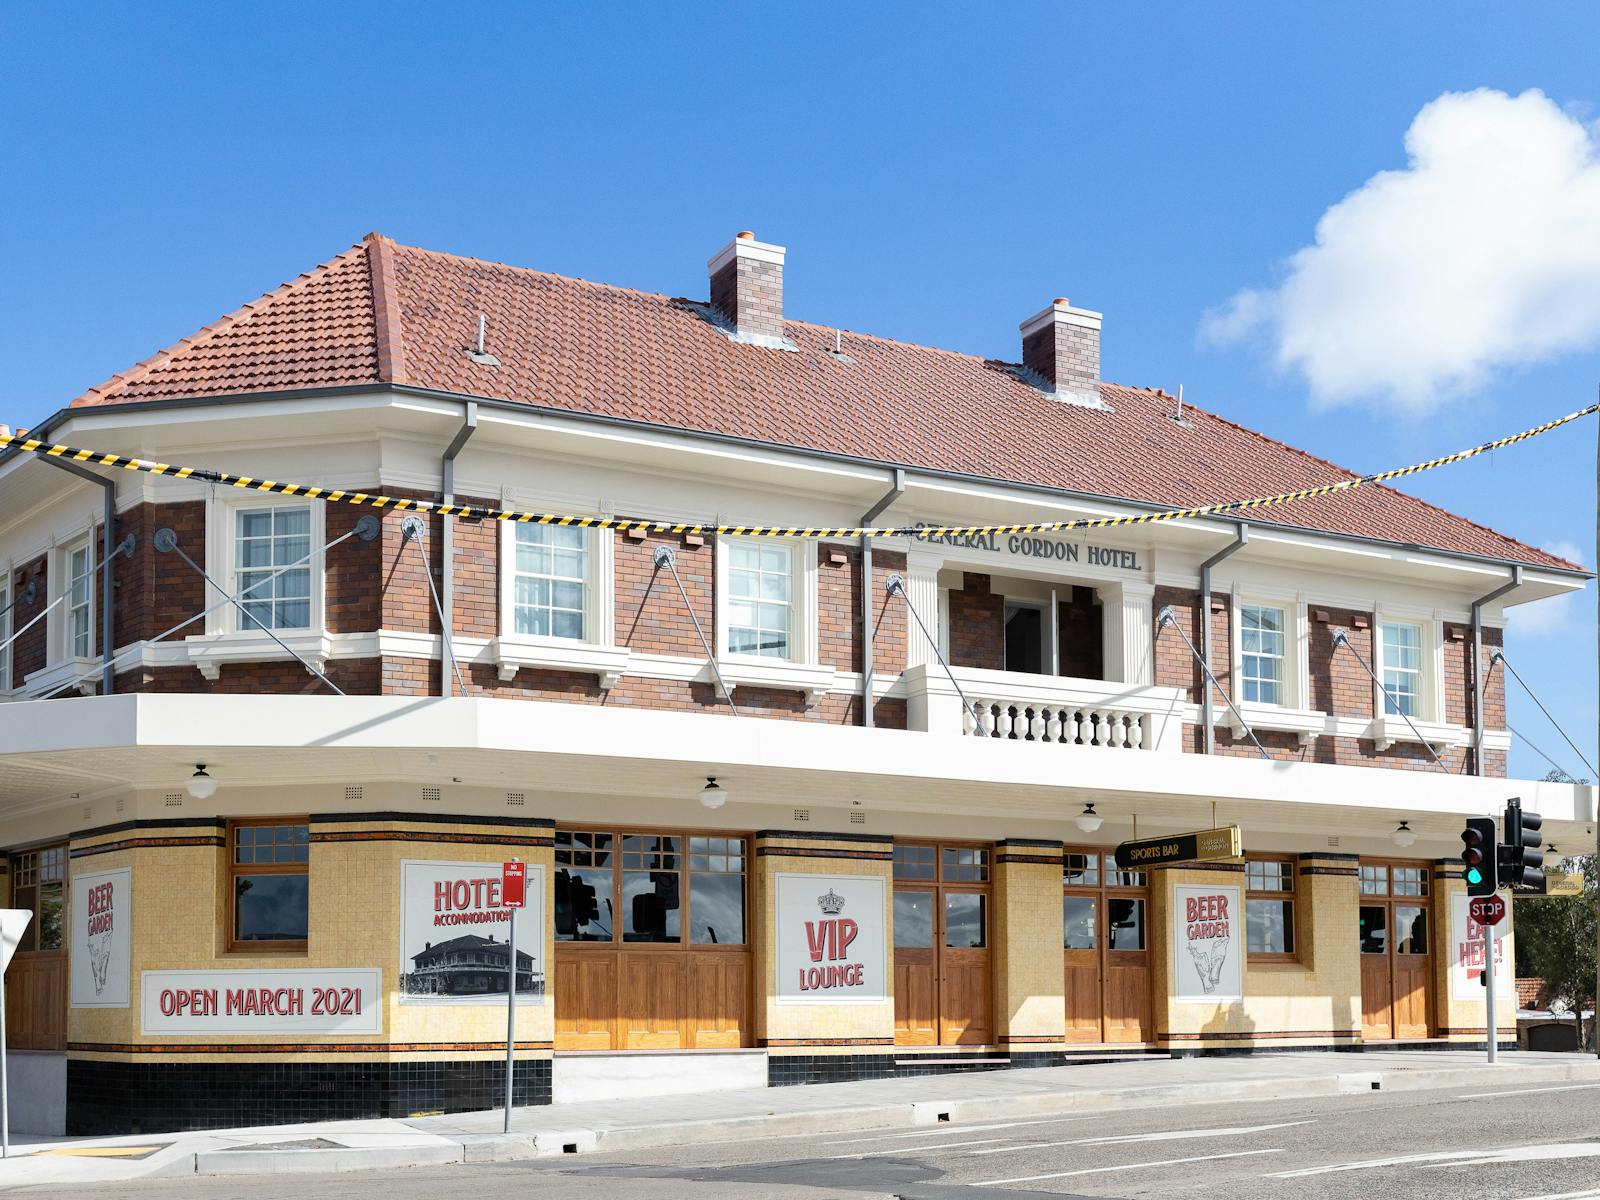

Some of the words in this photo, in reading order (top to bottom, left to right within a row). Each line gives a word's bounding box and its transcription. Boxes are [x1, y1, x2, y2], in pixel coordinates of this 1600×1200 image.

[914, 522, 1001, 552] GENERAL
[1007, 535, 1079, 562] GORDON
[1087, 545, 1142, 571] HOTEL
[1130, 845, 1161, 860] SPORTS
[1162, 843, 1180, 857] BAR
[88, 882, 114, 917] BEER
[433, 877, 503, 912] HOTE
[1186, 895, 1229, 922] BEER
[88, 912, 114, 937] GARDEN
[1187, 921, 1230, 940] GARDEN
[1466, 915, 1486, 940] EA
[804, 918, 859, 962] VIP
[799, 962, 865, 991] LOUNGE
[160, 988, 218, 1016] OPEN
[225, 988, 304, 1016] MARCH
[311, 987, 362, 1016] 2021
